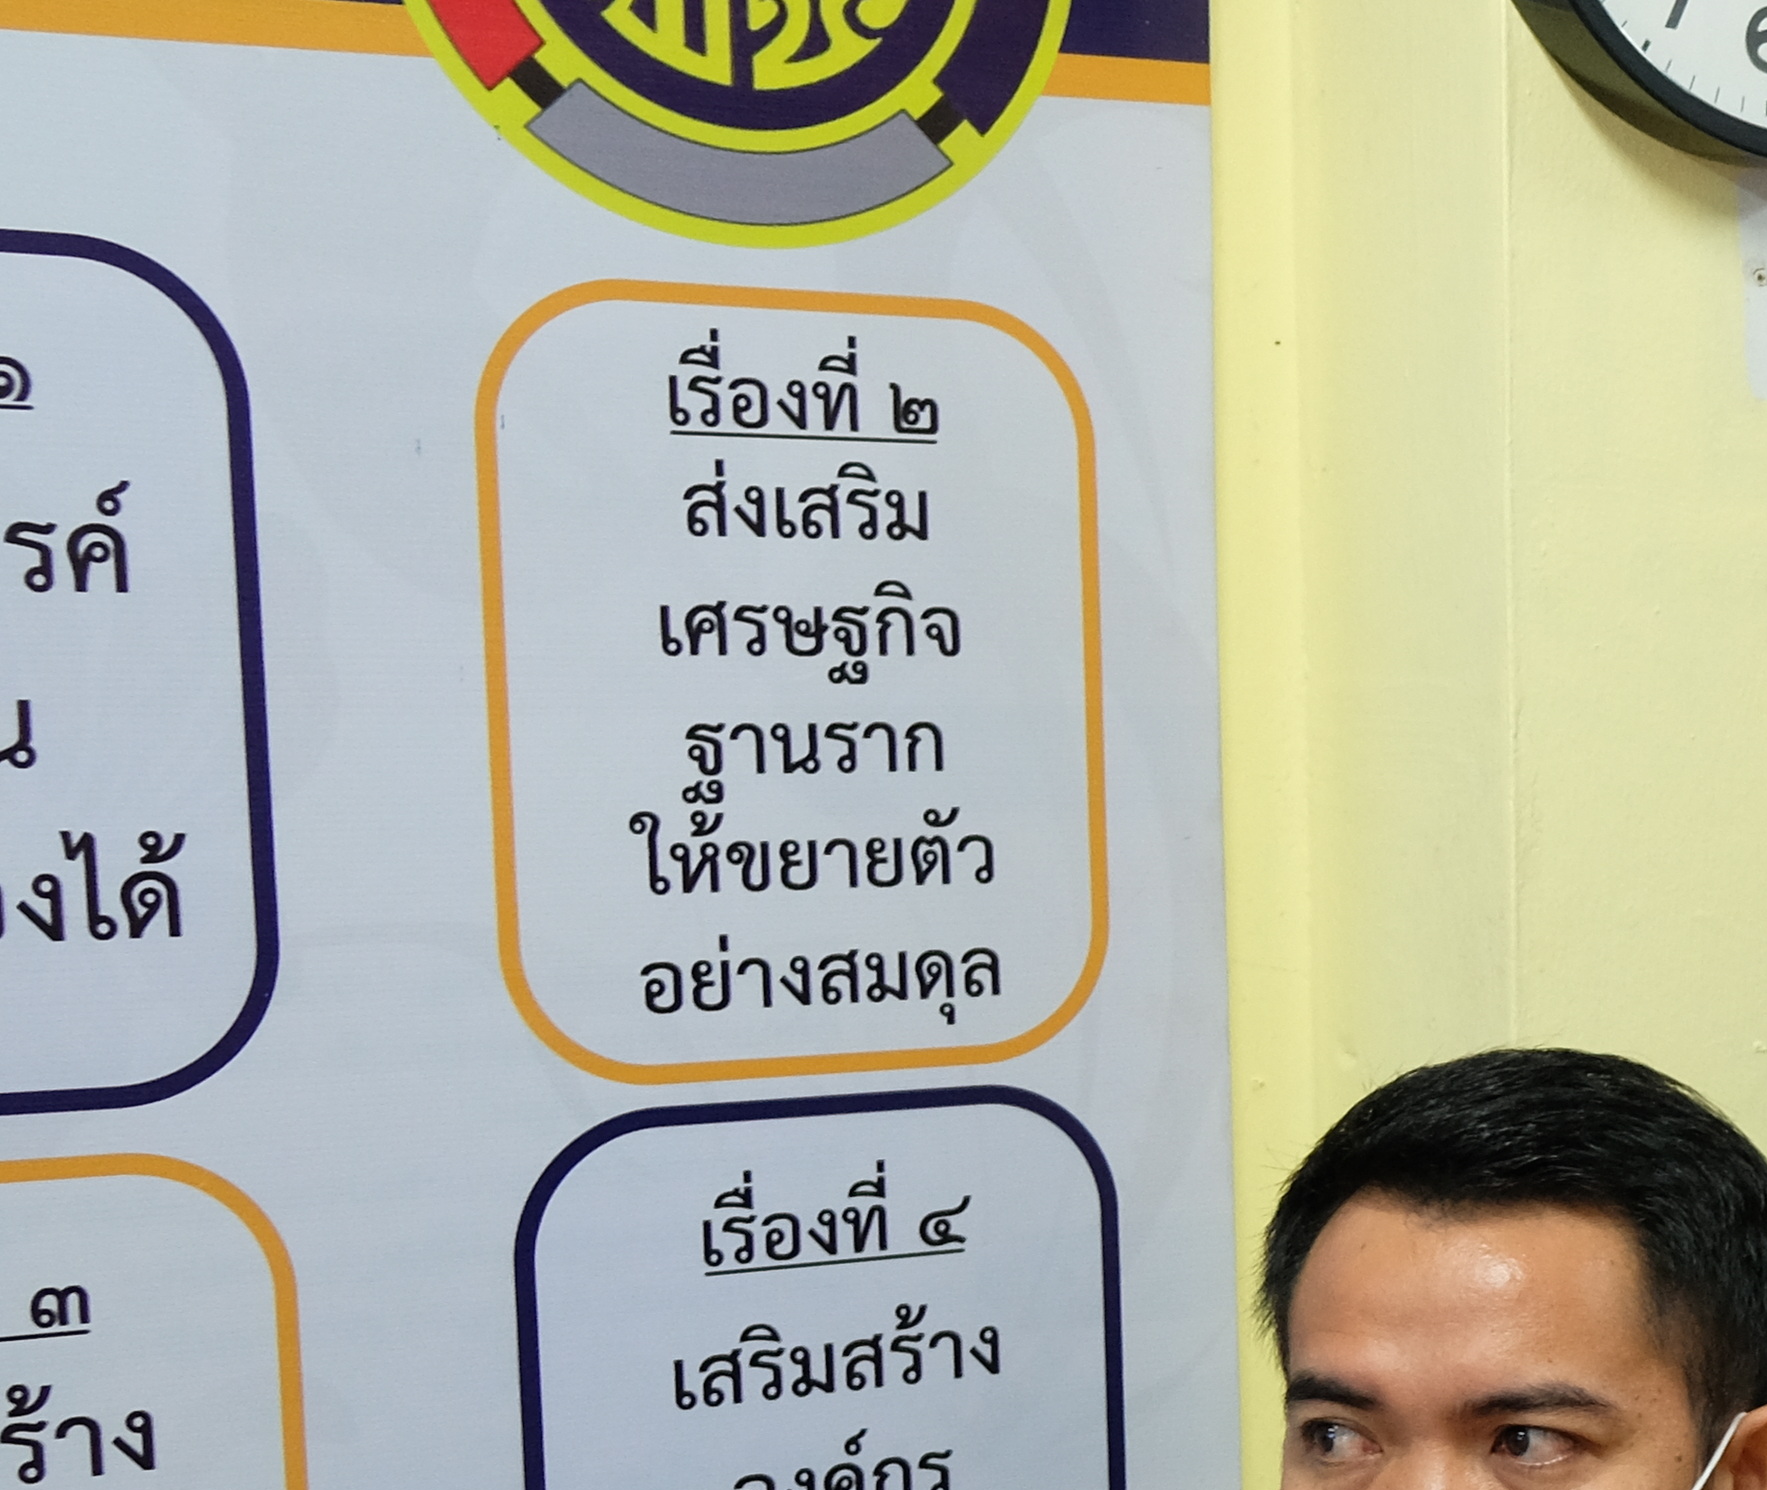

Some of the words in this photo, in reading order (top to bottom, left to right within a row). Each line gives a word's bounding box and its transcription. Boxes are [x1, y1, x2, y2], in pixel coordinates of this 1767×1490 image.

[668, 330, 860, 430] เรื่องที่
[891, 381, 940, 436] ๒
[683, 462, 928, 541] ส่งเสริม
[660, 580, 962, 683] เศรษฐกิจ
[685, 716, 945, 805] ฐานราก
[0, 830, 186, 942] งได้
[630, 807, 996, 895] ให้ขยายตัว
[641, 937, 1001, 1024] อย่างสมดุล
[702, 1161, 889, 1268] เรื่องที่
[919, 1194, 970, 1246] ๔
[673, 1303, 1003, 1410] เสริมสร้าง
